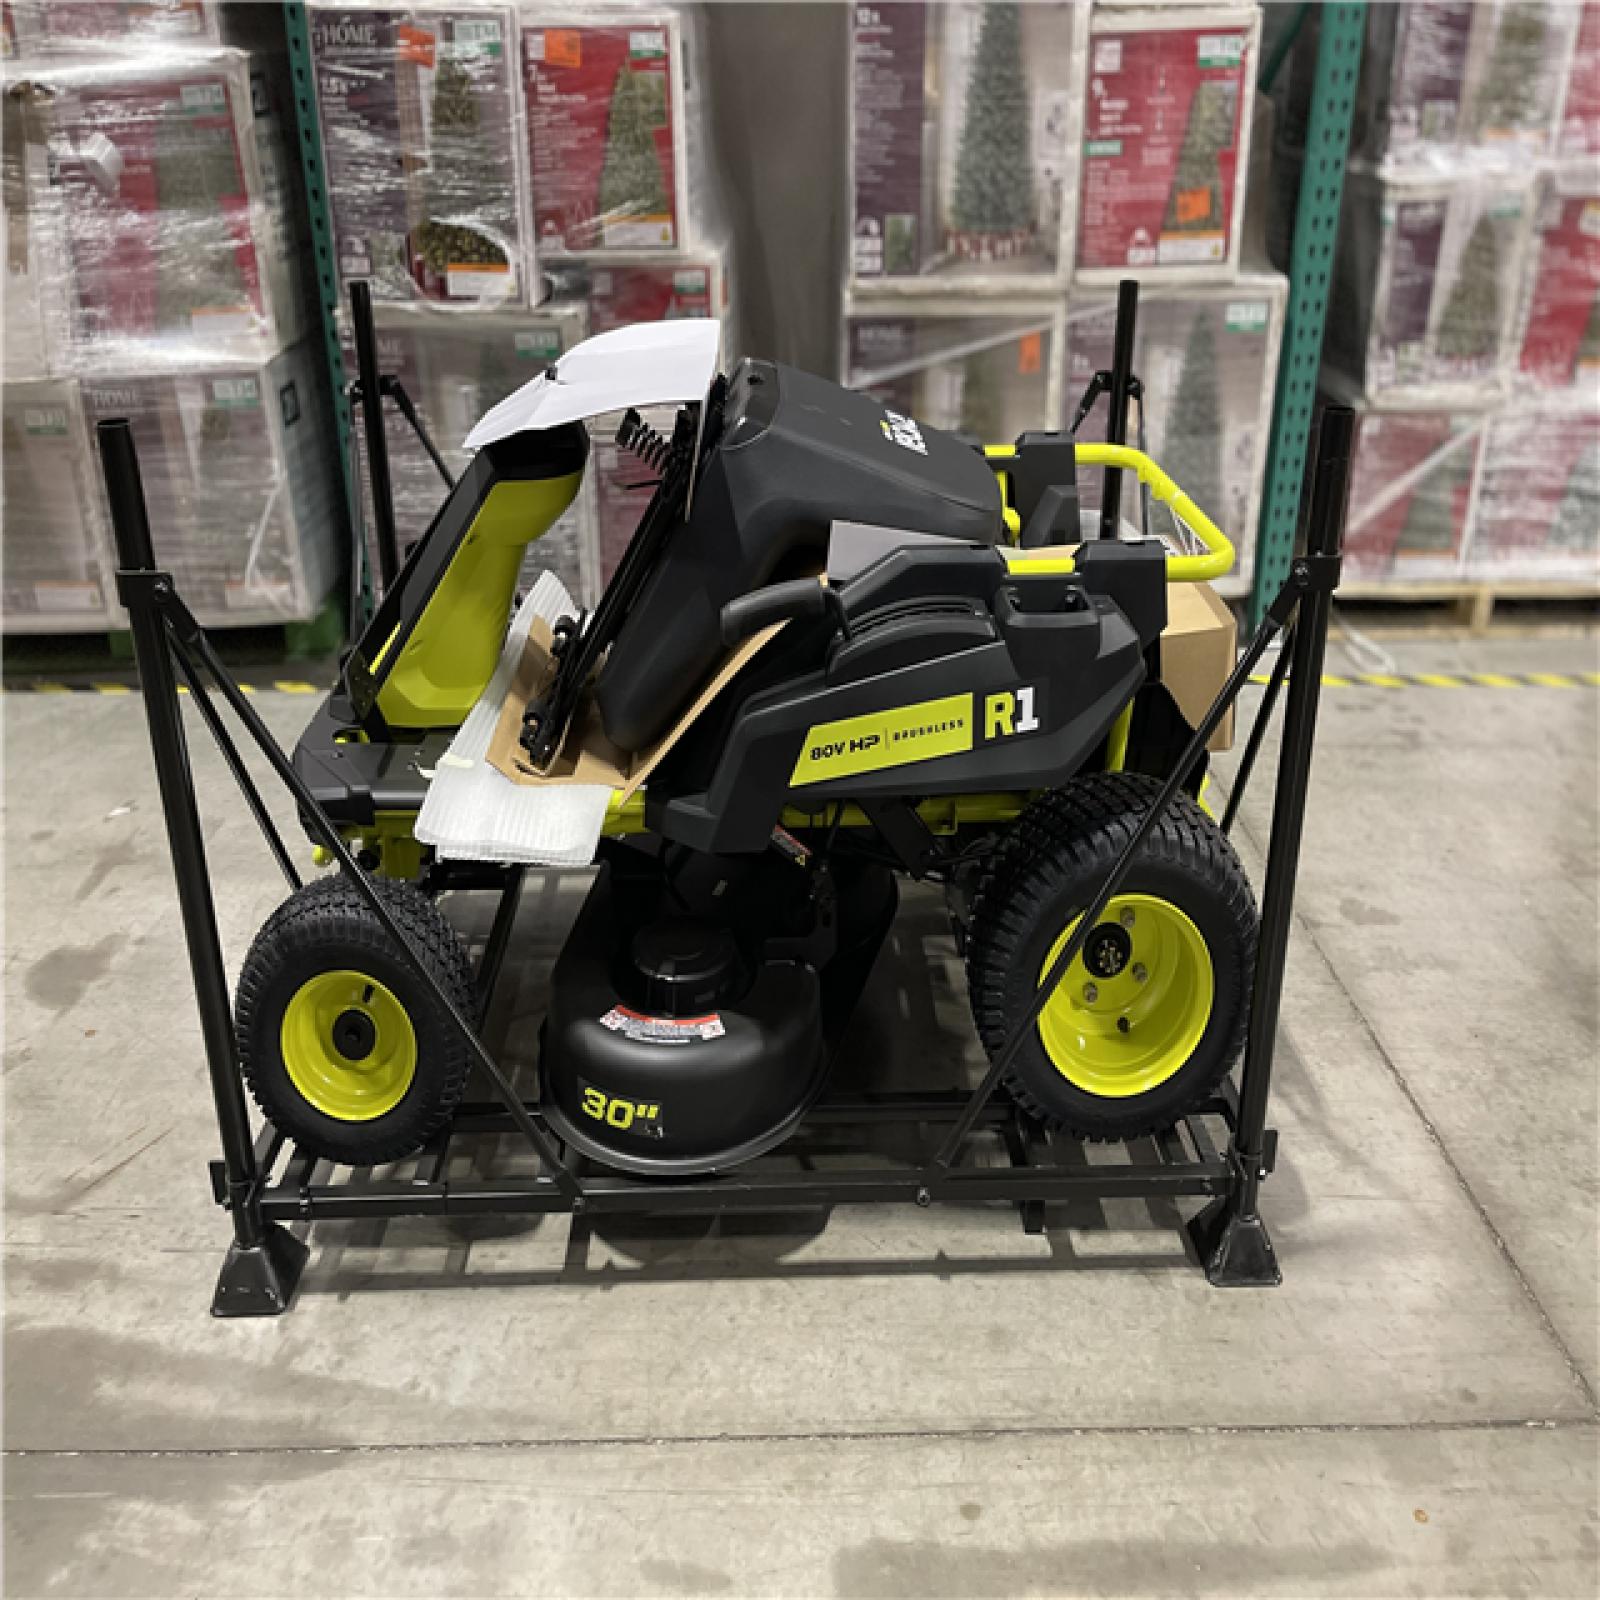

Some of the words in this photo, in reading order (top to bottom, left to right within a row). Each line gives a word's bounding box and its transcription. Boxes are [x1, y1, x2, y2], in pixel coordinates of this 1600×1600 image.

[985, 687, 1039, 740] R1
[810, 742, 845, 760] 80V
[849, 735, 880, 753] HP
[582, 1088, 660, 1129] 30"
